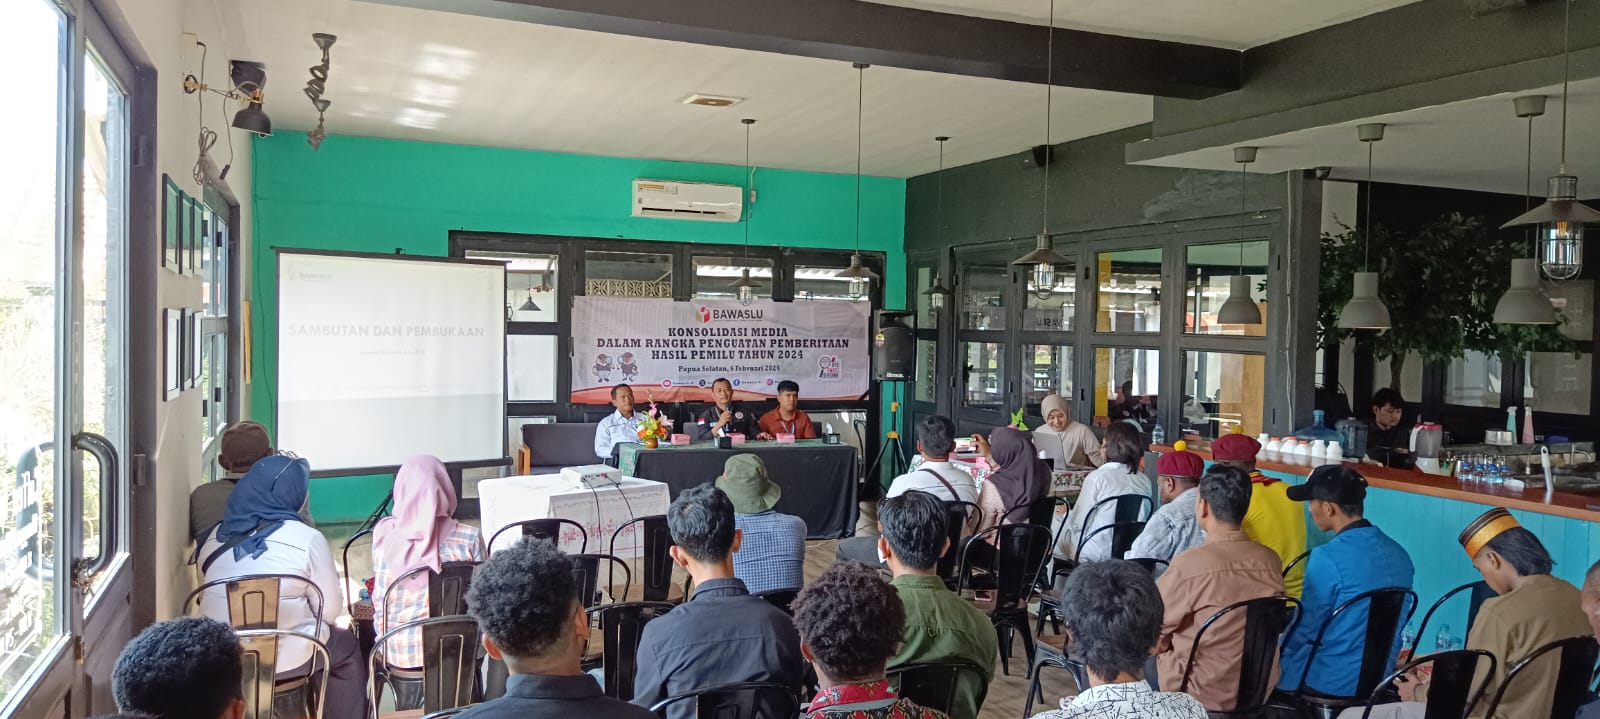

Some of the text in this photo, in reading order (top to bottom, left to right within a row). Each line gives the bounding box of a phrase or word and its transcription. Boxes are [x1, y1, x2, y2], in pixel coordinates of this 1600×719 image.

[713, 309, 763, 319] BAWASLU
[288, 324, 485, 337] SAMBUTAN DAN PEMBUKAAN
[668, 327, 788, 337] KONSOLIDASI MEDIA
[597, 338, 849, 348] DALAM RANGKA PENGUATAN PEMBERITAAN
[651, 349, 804, 360] HASIL PEMILU TAHUN 2024
[678, 365, 701, 374] Papua
[701, 365, 730, 373] Selatan,
